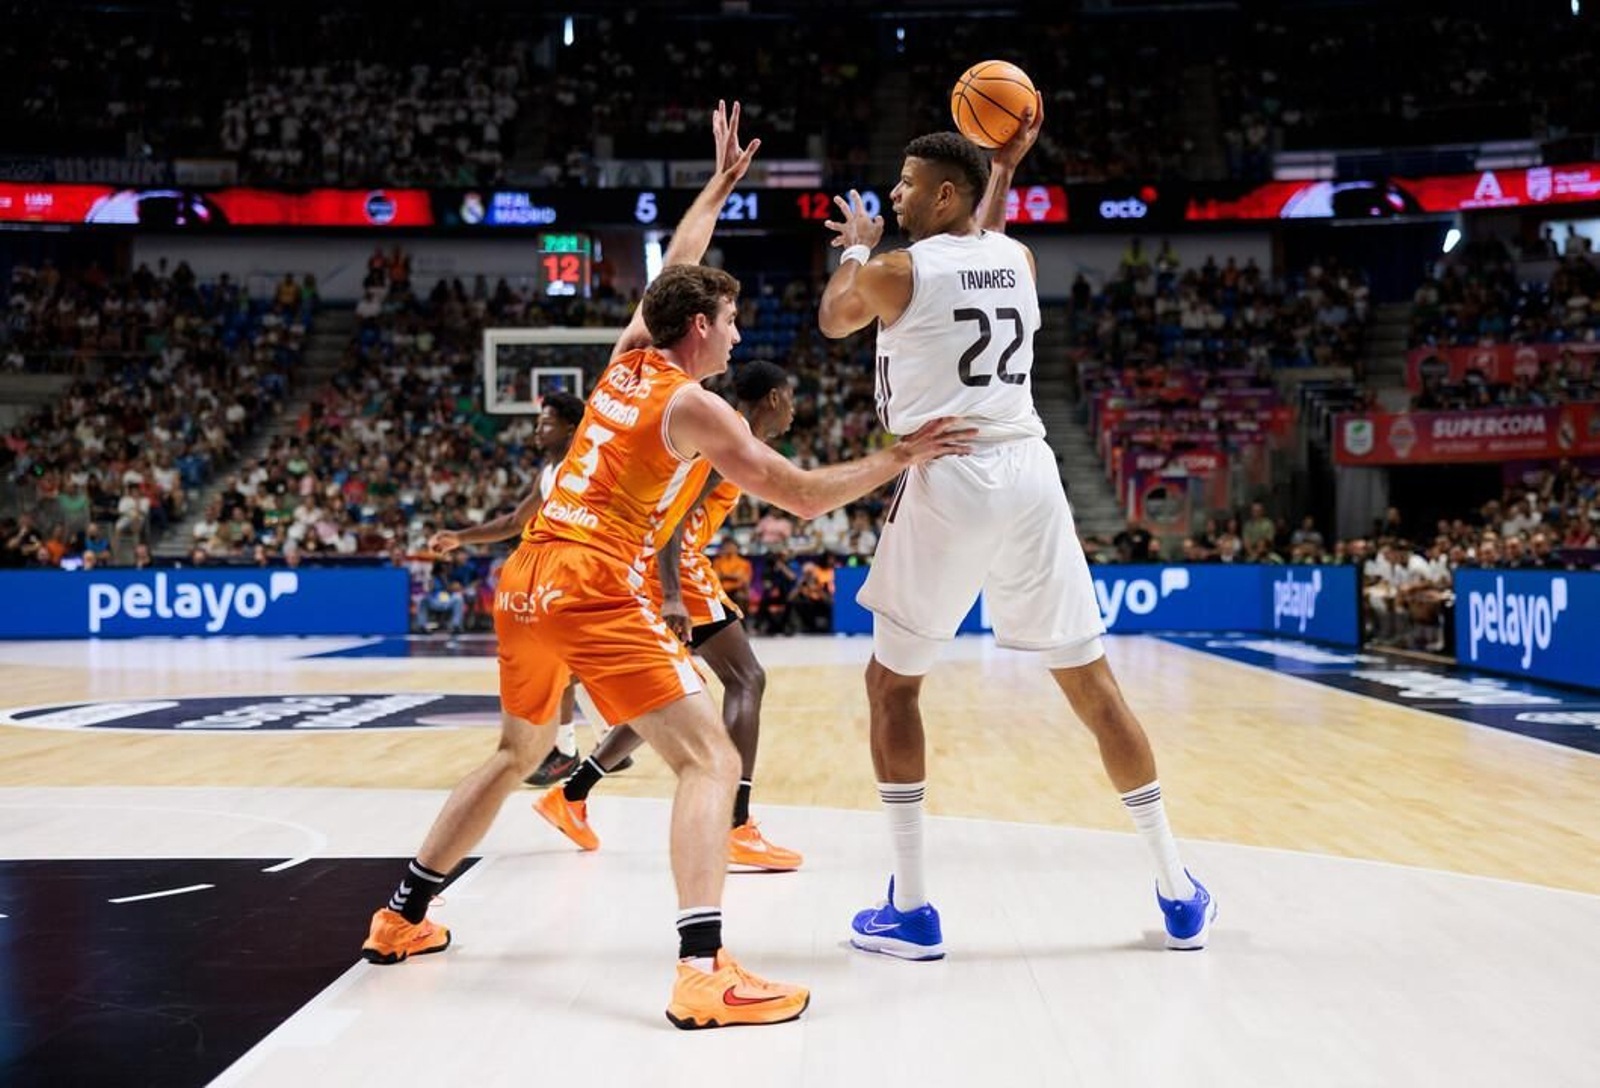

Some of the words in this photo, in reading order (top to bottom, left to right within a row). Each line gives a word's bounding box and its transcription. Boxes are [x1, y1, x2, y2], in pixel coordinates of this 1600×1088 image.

[494, 207, 557, 224] MADRID
[635, 193, 656, 223] 5
[797, 193, 830, 219] 12
[1100, 196, 1148, 218] acb
[543, 254, 580, 281] 12
[957, 268, 1016, 290] TAVARES
[953, 307, 1027, 387] 22
[1432, 415, 1547, 438] SUPERCOPA
[559, 423, 616, 494] 3
[88, 571, 267, 633] pelayo
[1273, 569, 1315, 632] pelayo
[1469, 575, 1552, 669] pelayo
